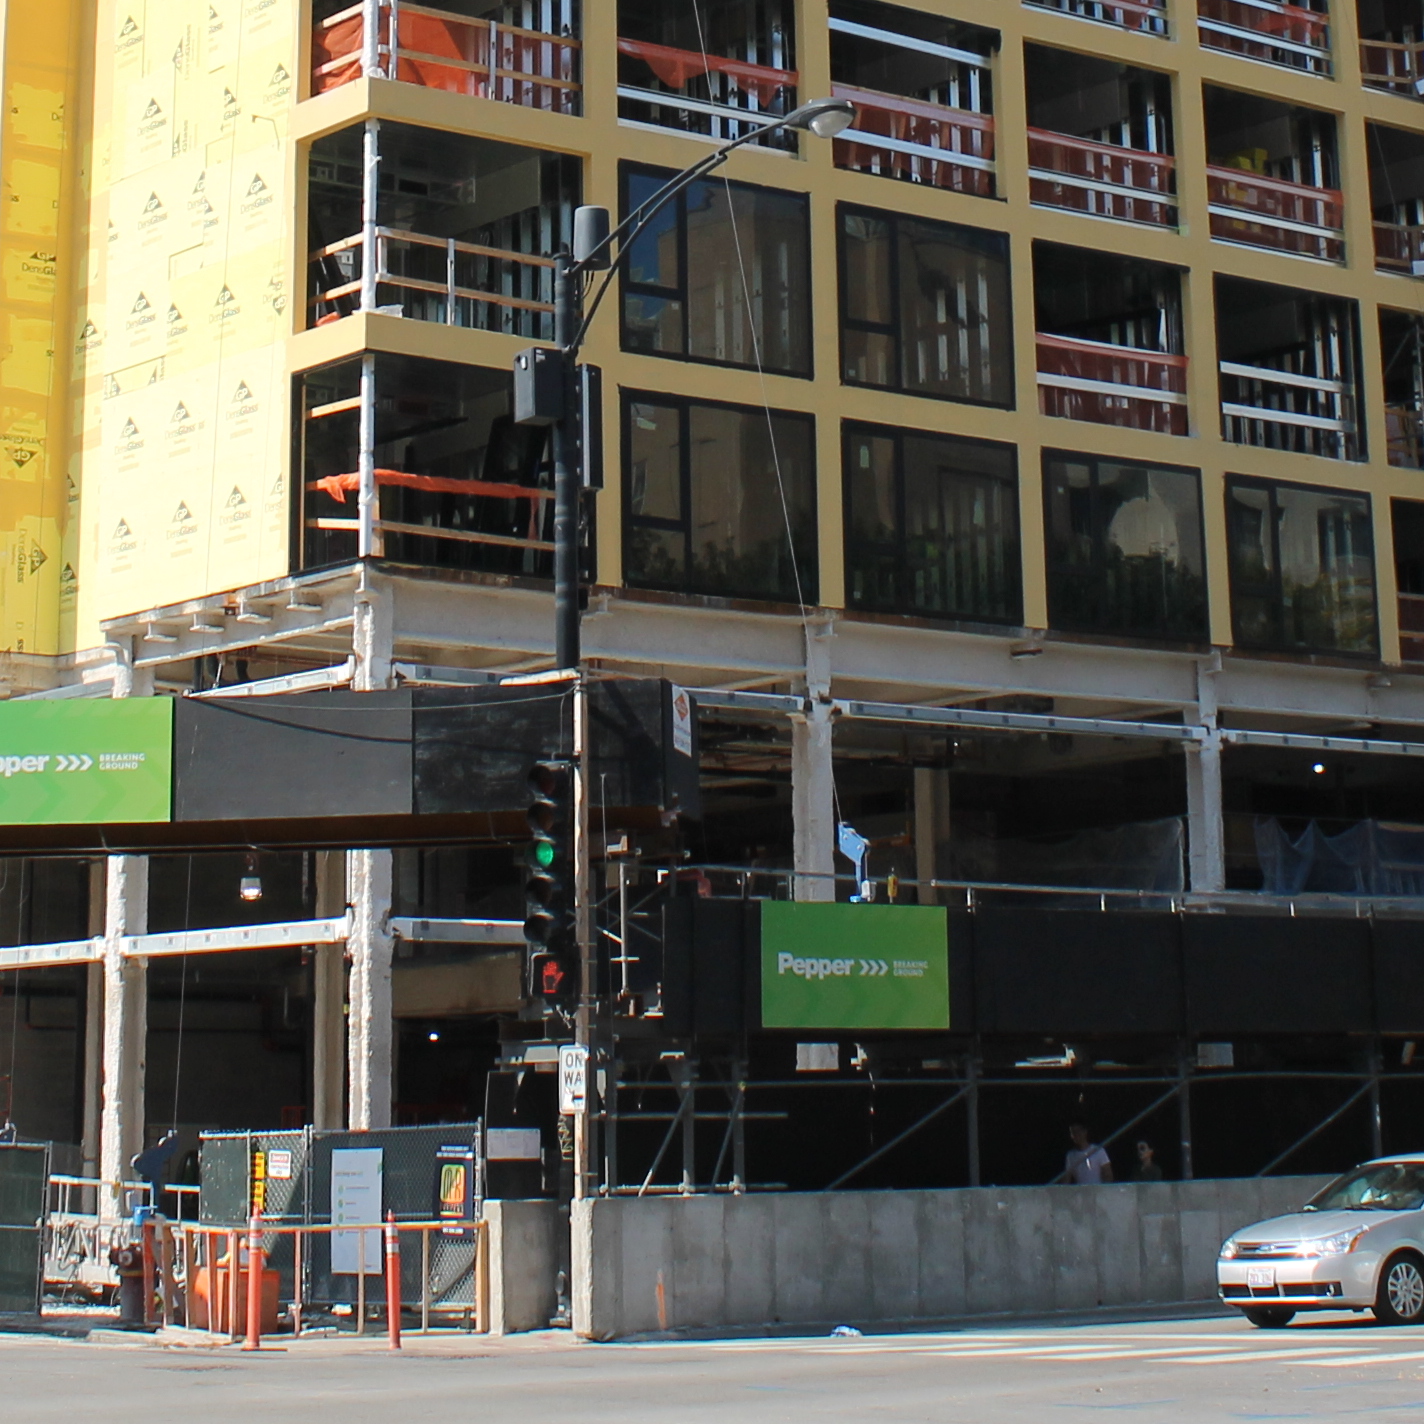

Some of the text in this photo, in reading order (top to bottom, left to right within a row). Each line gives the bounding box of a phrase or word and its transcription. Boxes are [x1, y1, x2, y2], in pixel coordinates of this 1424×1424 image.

[240, 194, 274, 215] DensGlass
[208, 306, 241, 324] DensGlass
[225, 403, 259, 421] DensGlass
[165, 423, 196, 440] DensGlass
[219, 510, 251, 526] DensGlass
[166, 524, 198, 541] DensGlass
[17, 528, 28, 584] DensGlass
[99, 753, 146, 762] BREAKING
[99, 761, 139, 771] GROUND
[778, 951, 929, 980] Pepper BREAKING
[893, 968, 925, 977] GROUND
[565, 1052, 583, 1068] ON
[564, 1071, 584, 1086] WA
